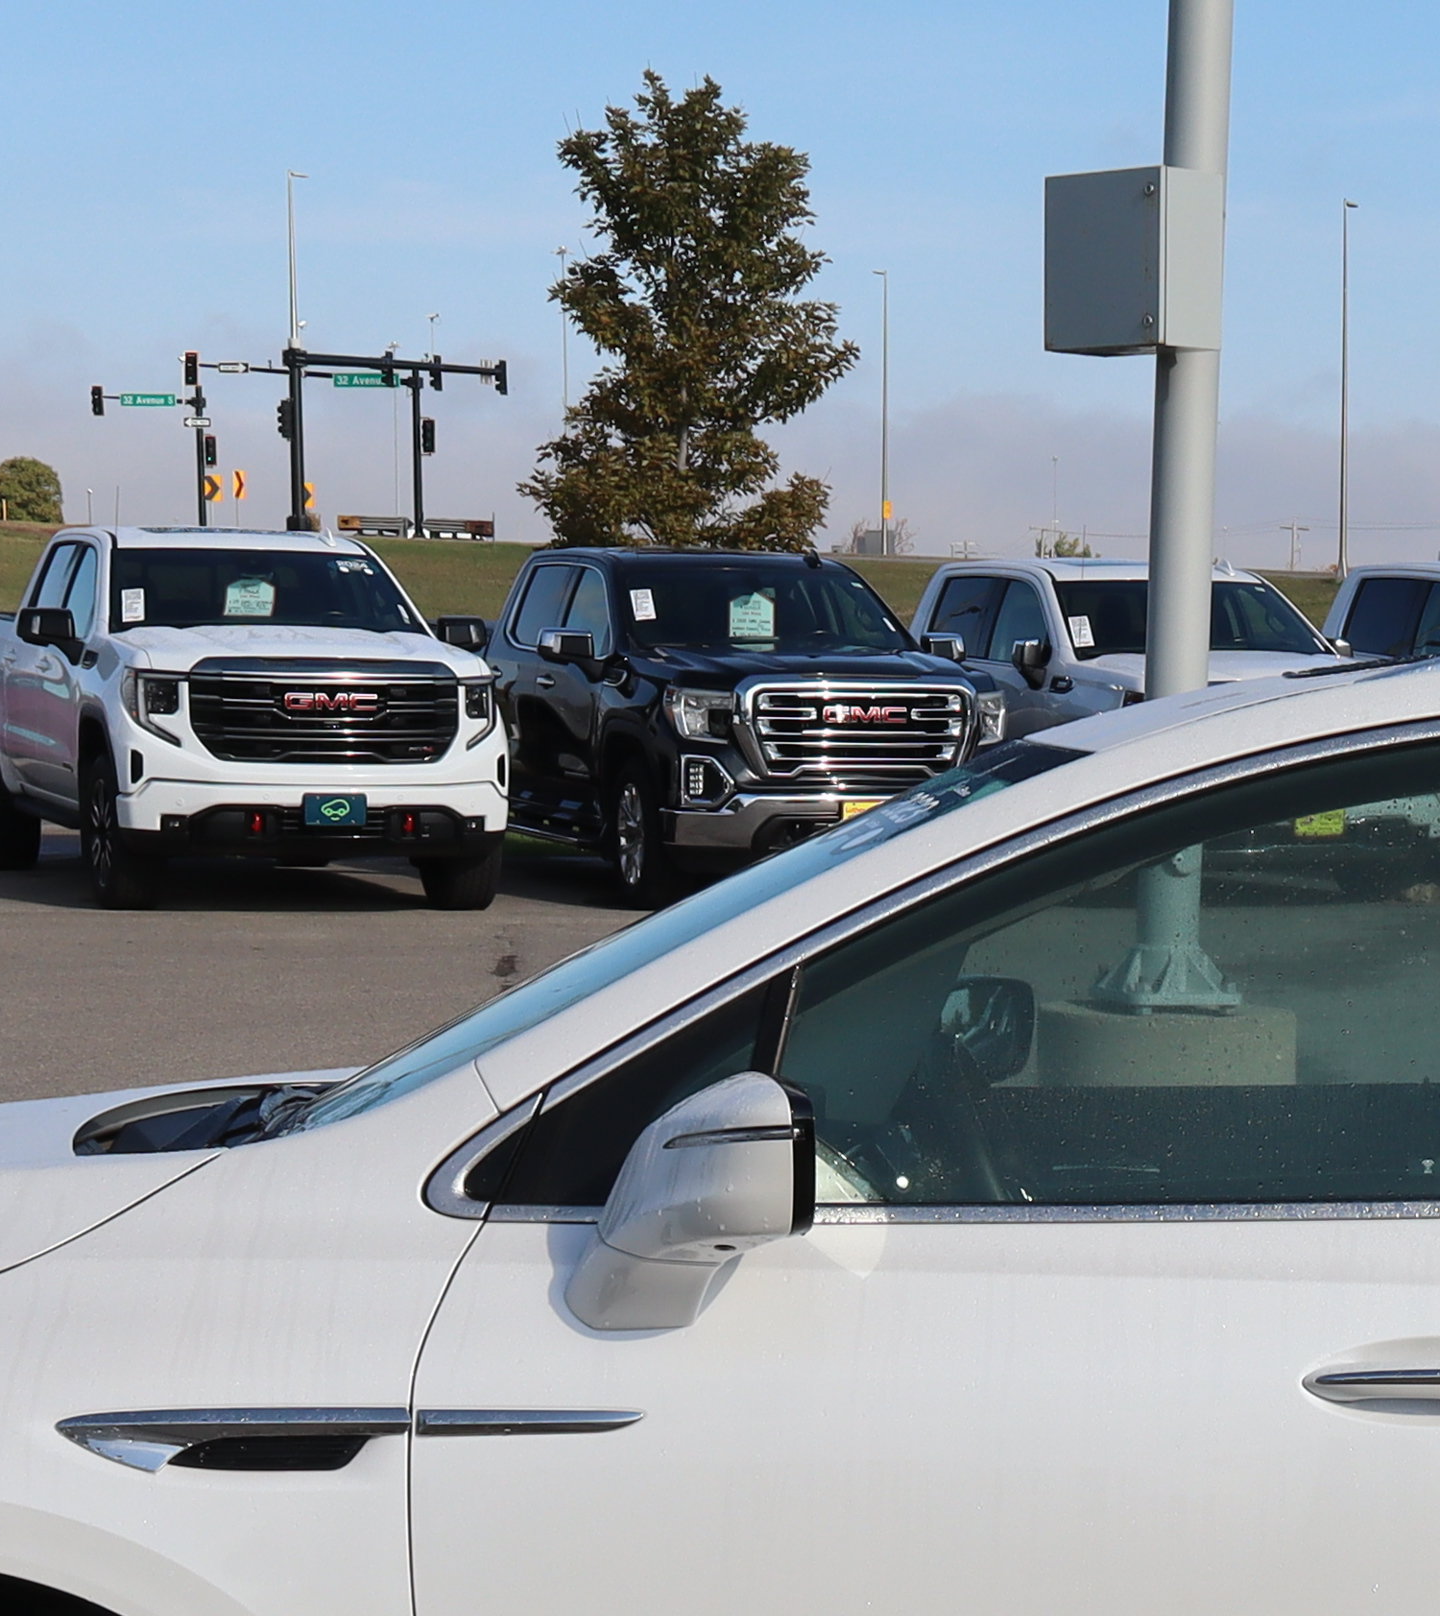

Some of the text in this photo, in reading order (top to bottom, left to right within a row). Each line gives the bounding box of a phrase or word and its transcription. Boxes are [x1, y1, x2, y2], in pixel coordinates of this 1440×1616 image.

[335, 375, 349, 385] 32
[352, 375, 387, 386] Avenu
[122, 396, 174, 405] 32 Avenue S
[284, 692, 378, 711] GMC
[822, 705, 907, 724] GMC
